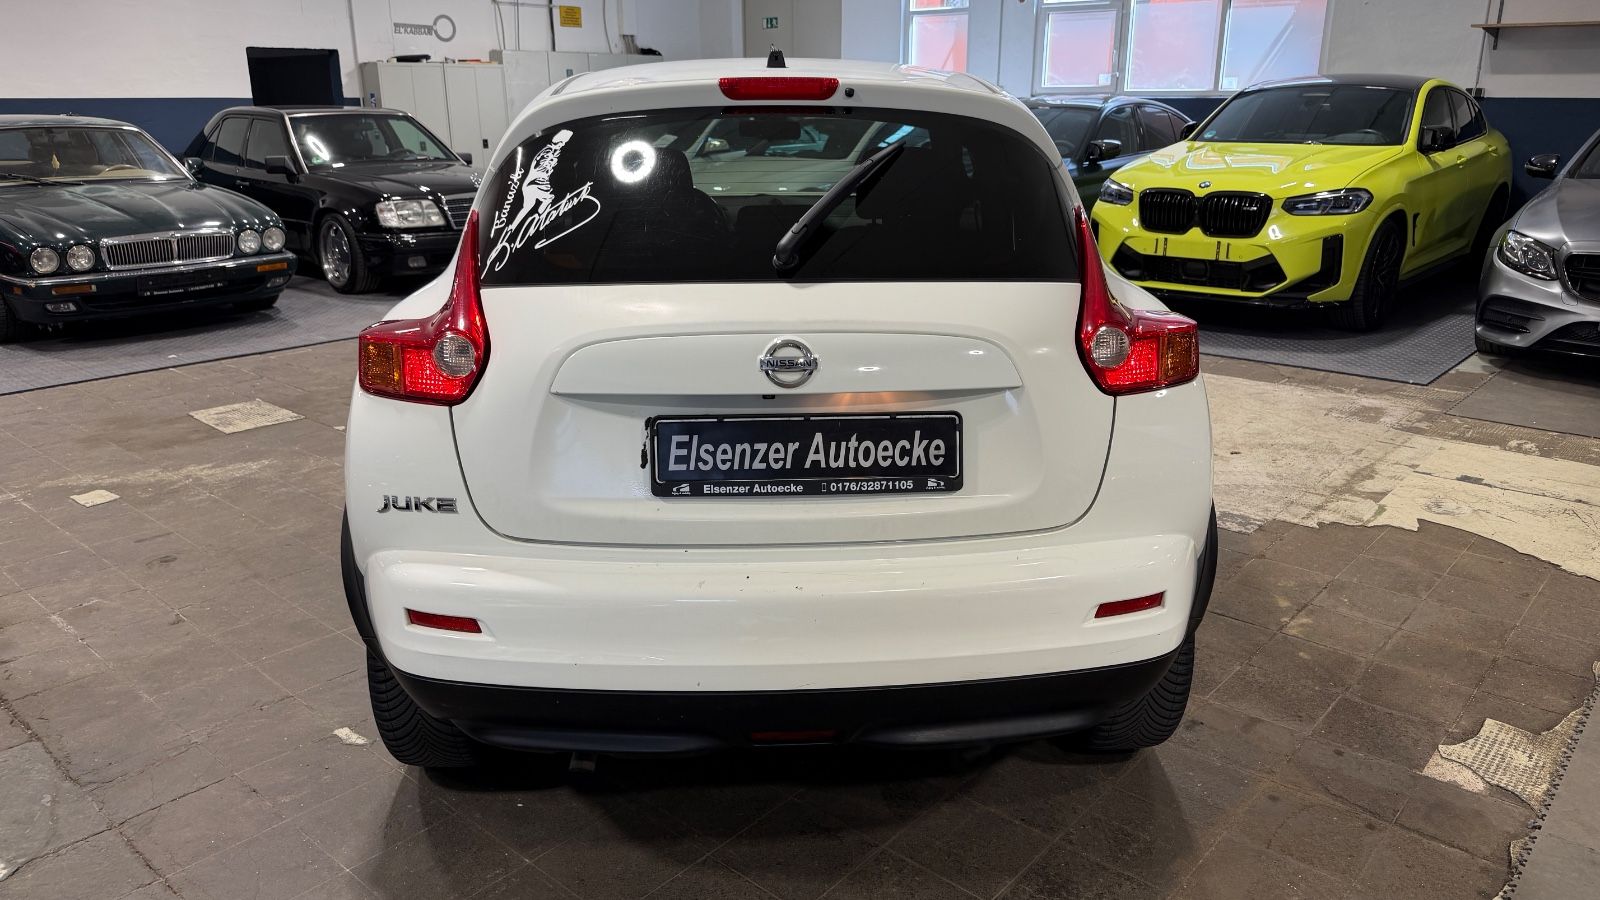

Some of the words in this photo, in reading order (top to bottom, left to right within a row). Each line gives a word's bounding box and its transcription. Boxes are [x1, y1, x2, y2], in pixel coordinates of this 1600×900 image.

[766, 359, 812, 368] NISSAN
[668, 434, 799, 471] Elsenzer
[804, 430, 946, 469] Autoecke
[703, 484, 750, 494] Elsenzer
[753, 483, 804, 493] Autoecke
[830, 480, 914, 492] 0176/32871105
[376, 494, 459, 514] JUKE
